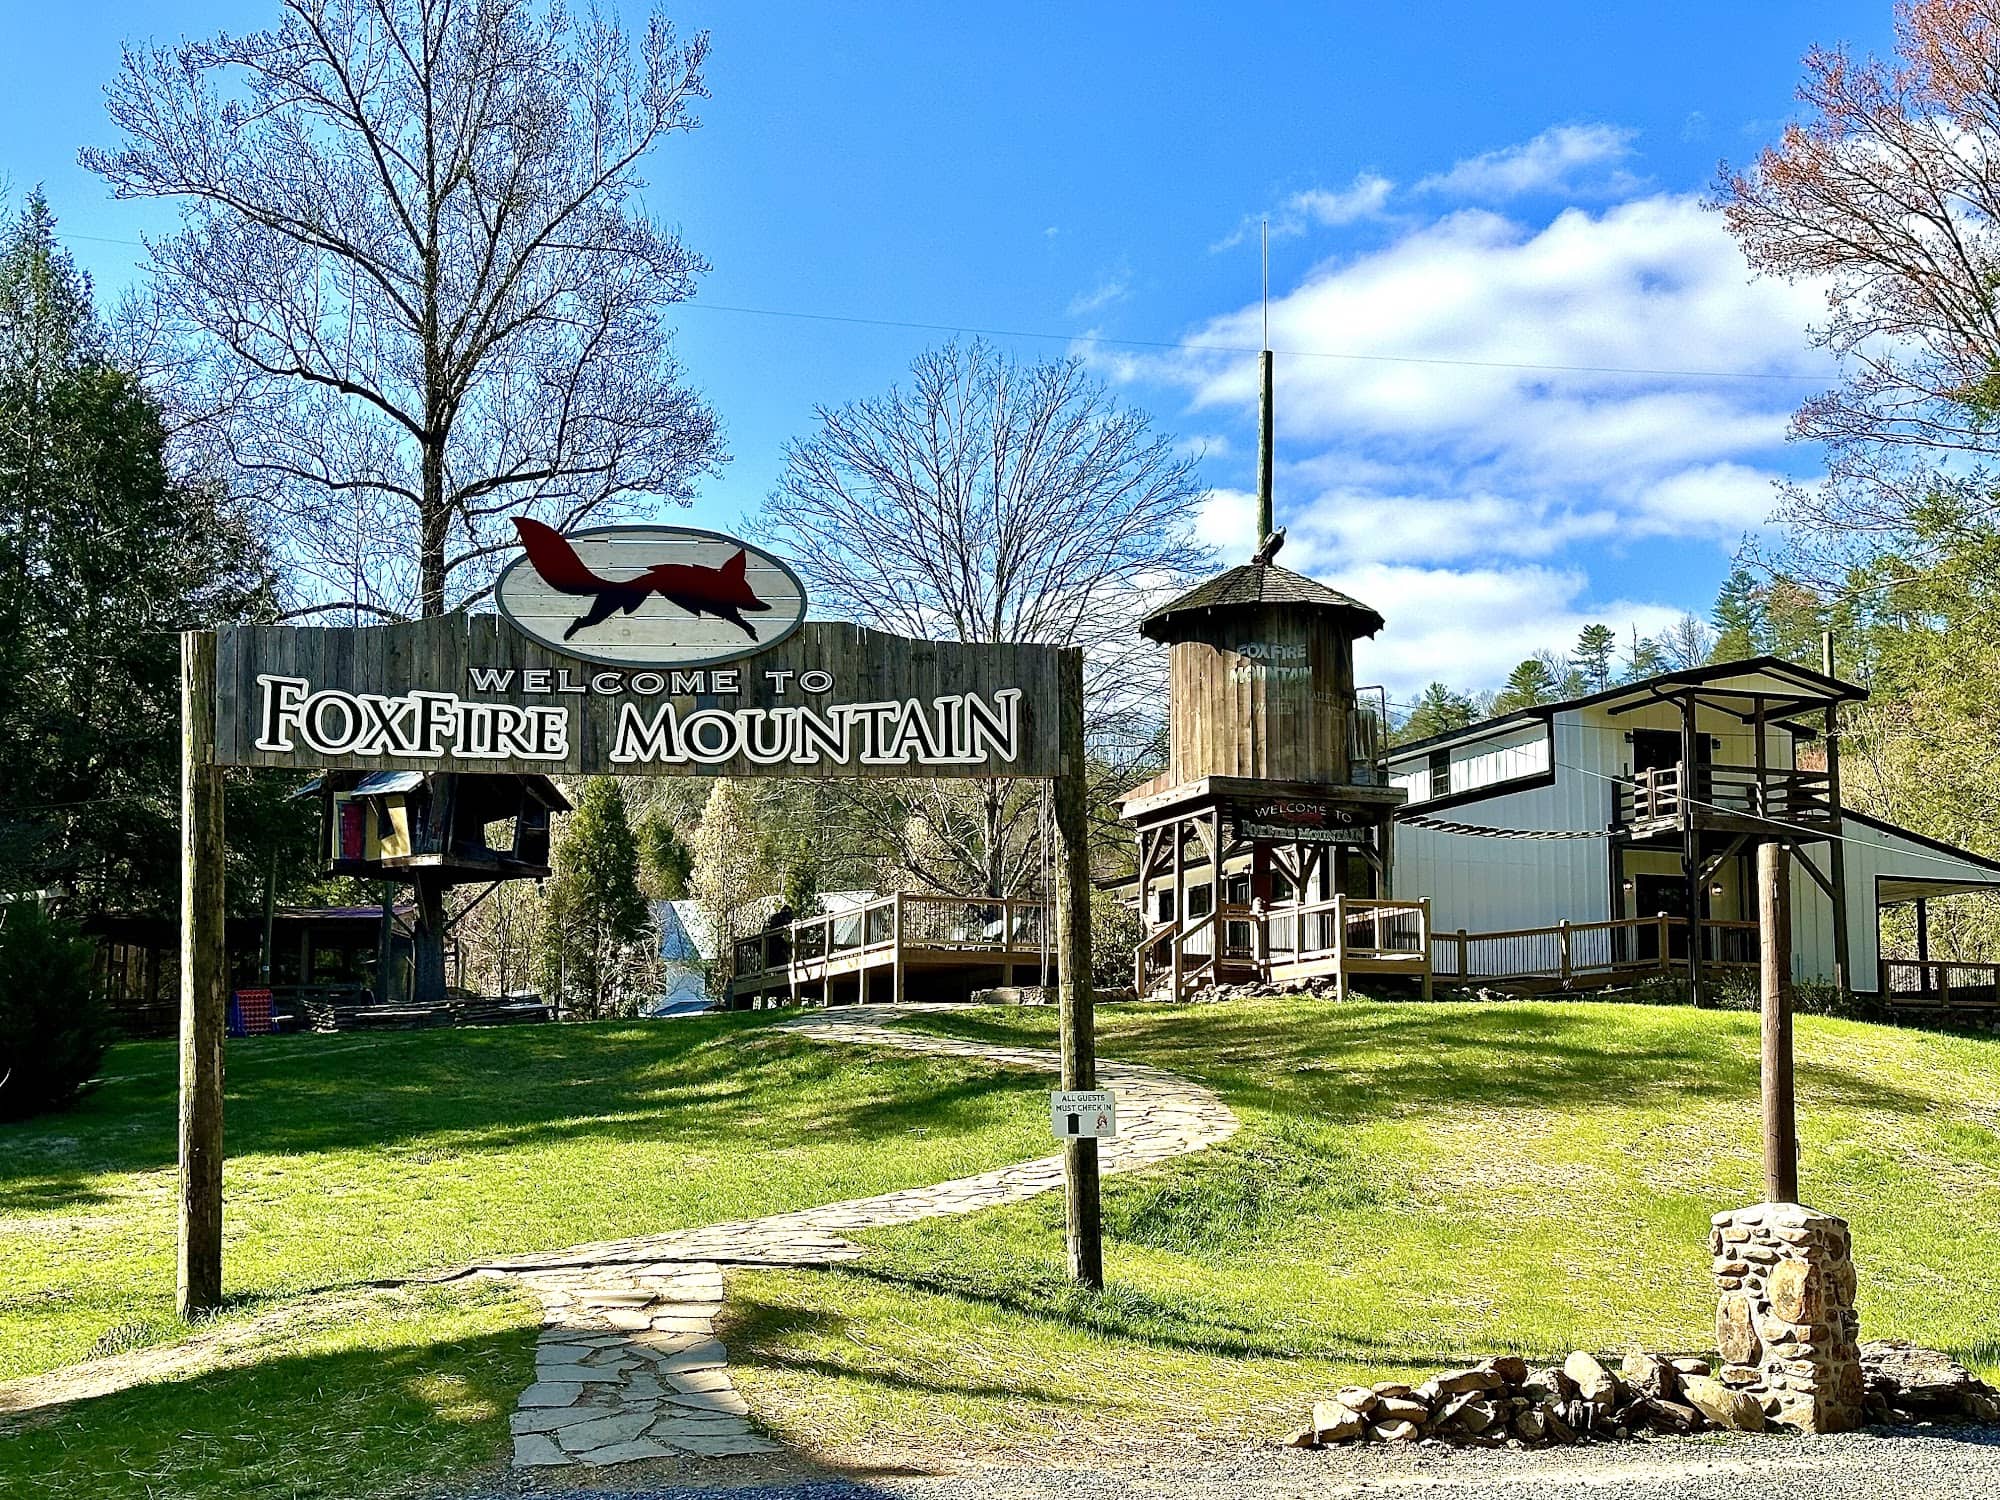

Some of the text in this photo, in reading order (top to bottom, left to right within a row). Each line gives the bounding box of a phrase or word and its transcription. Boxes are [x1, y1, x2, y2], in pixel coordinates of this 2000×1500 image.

[1237, 642, 1307, 660] FOXFIRE
[469, 668, 835, 695] WELCOME TO
[1231, 666, 1312, 683] MOUNTAIN
[255, 674, 1021, 764] FOXFIRE MOUNTAIN
[1254, 803, 1353, 824] WELCOME TO
[1298, 827, 1365, 842] MOUNTAIN
